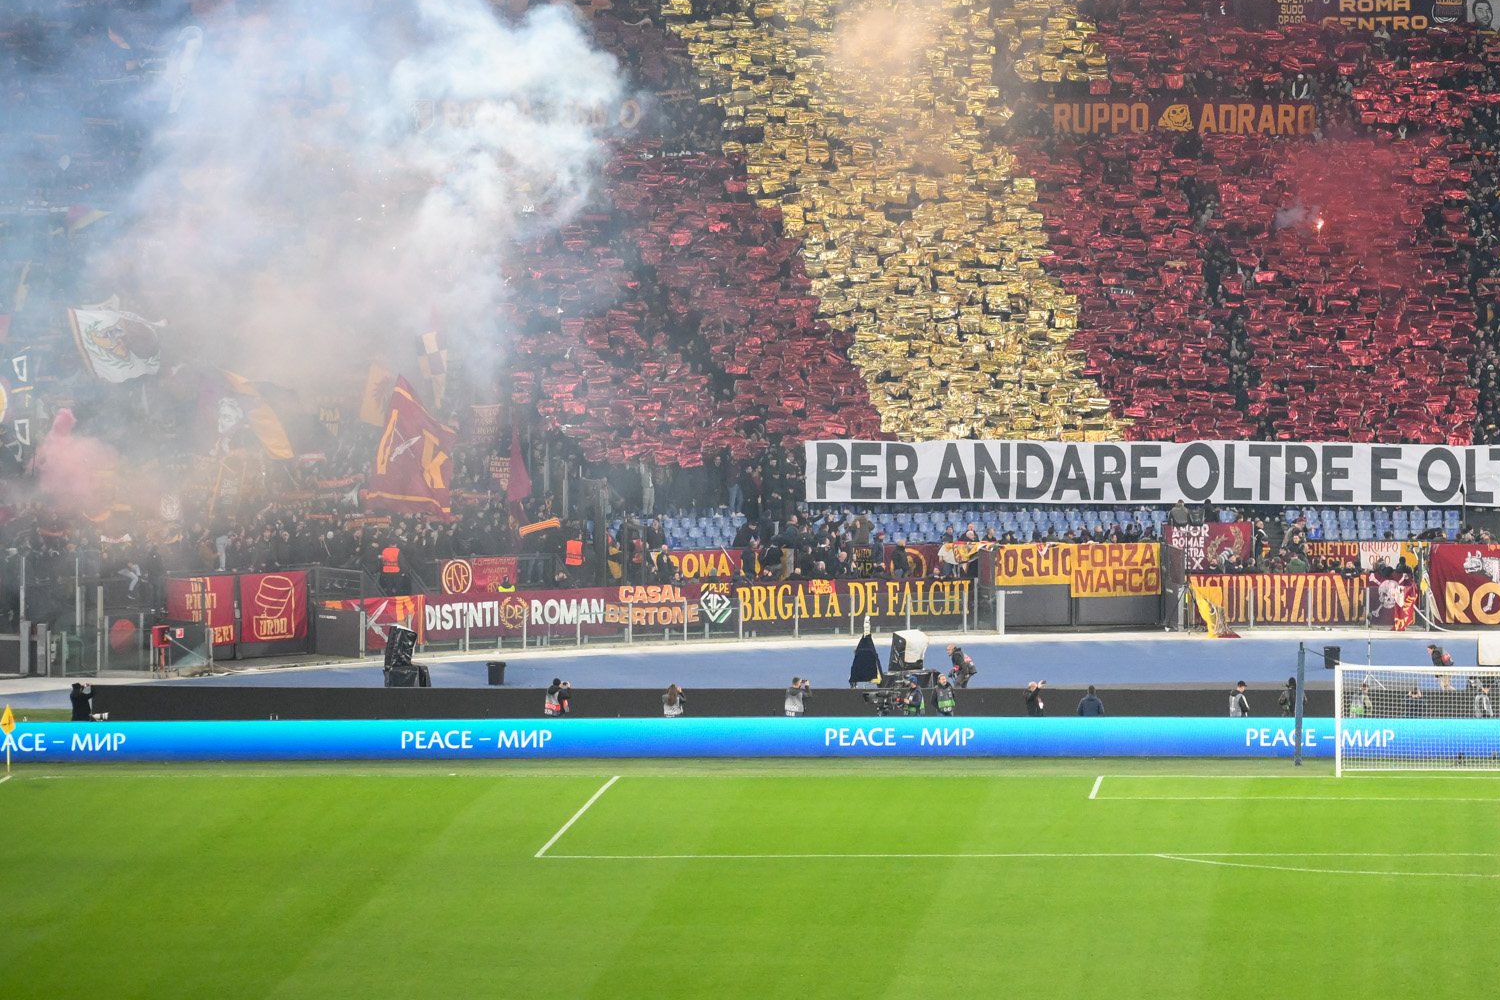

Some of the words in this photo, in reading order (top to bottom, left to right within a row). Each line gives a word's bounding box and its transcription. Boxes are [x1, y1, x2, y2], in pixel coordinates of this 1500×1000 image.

[1280, 4, 1304, 15] SUDO
[816, 442, 920, 500] PER
[931, 443, 1162, 501] ANDARE
[1176, 443, 1354, 502] OLTRE
[1370, 446, 1403, 503] E
[1171, 523, 1210, 539] AMOR
[1171, 537, 1205, 548] ROMAE
[1183, 547, 1206, 558] STRA
[1360, 541, 1399, 555] GRUPPO
[1077, 544, 1156, 568] FORZA
[708, 582, 730, 594] PEPE
[1074, 568, 1160, 594] MARCO
[618, 585, 687, 604] CASAL
[737, 582, 842, 622] BRIGATA
[847, 580, 880, 618] DE
[886, 578, 972, 616] FALCHI
[1184, 575, 1367, 623] URREZIONE
[425, 600, 499, 631] DISTINTI
[605, 603, 699, 626] BERTONE
[0, 733, 47, 752] ACE
[71, 733, 126, 751] МИР
[401, 730, 473, 749] PEACE
[497, 729, 552, 748] МИР
[825, 727, 897, 747] PEACE
[920, 727, 975, 746] МИР
[1246, 728, 1317, 747] PEACE
[1341, 729, 1395, 748] МИР
